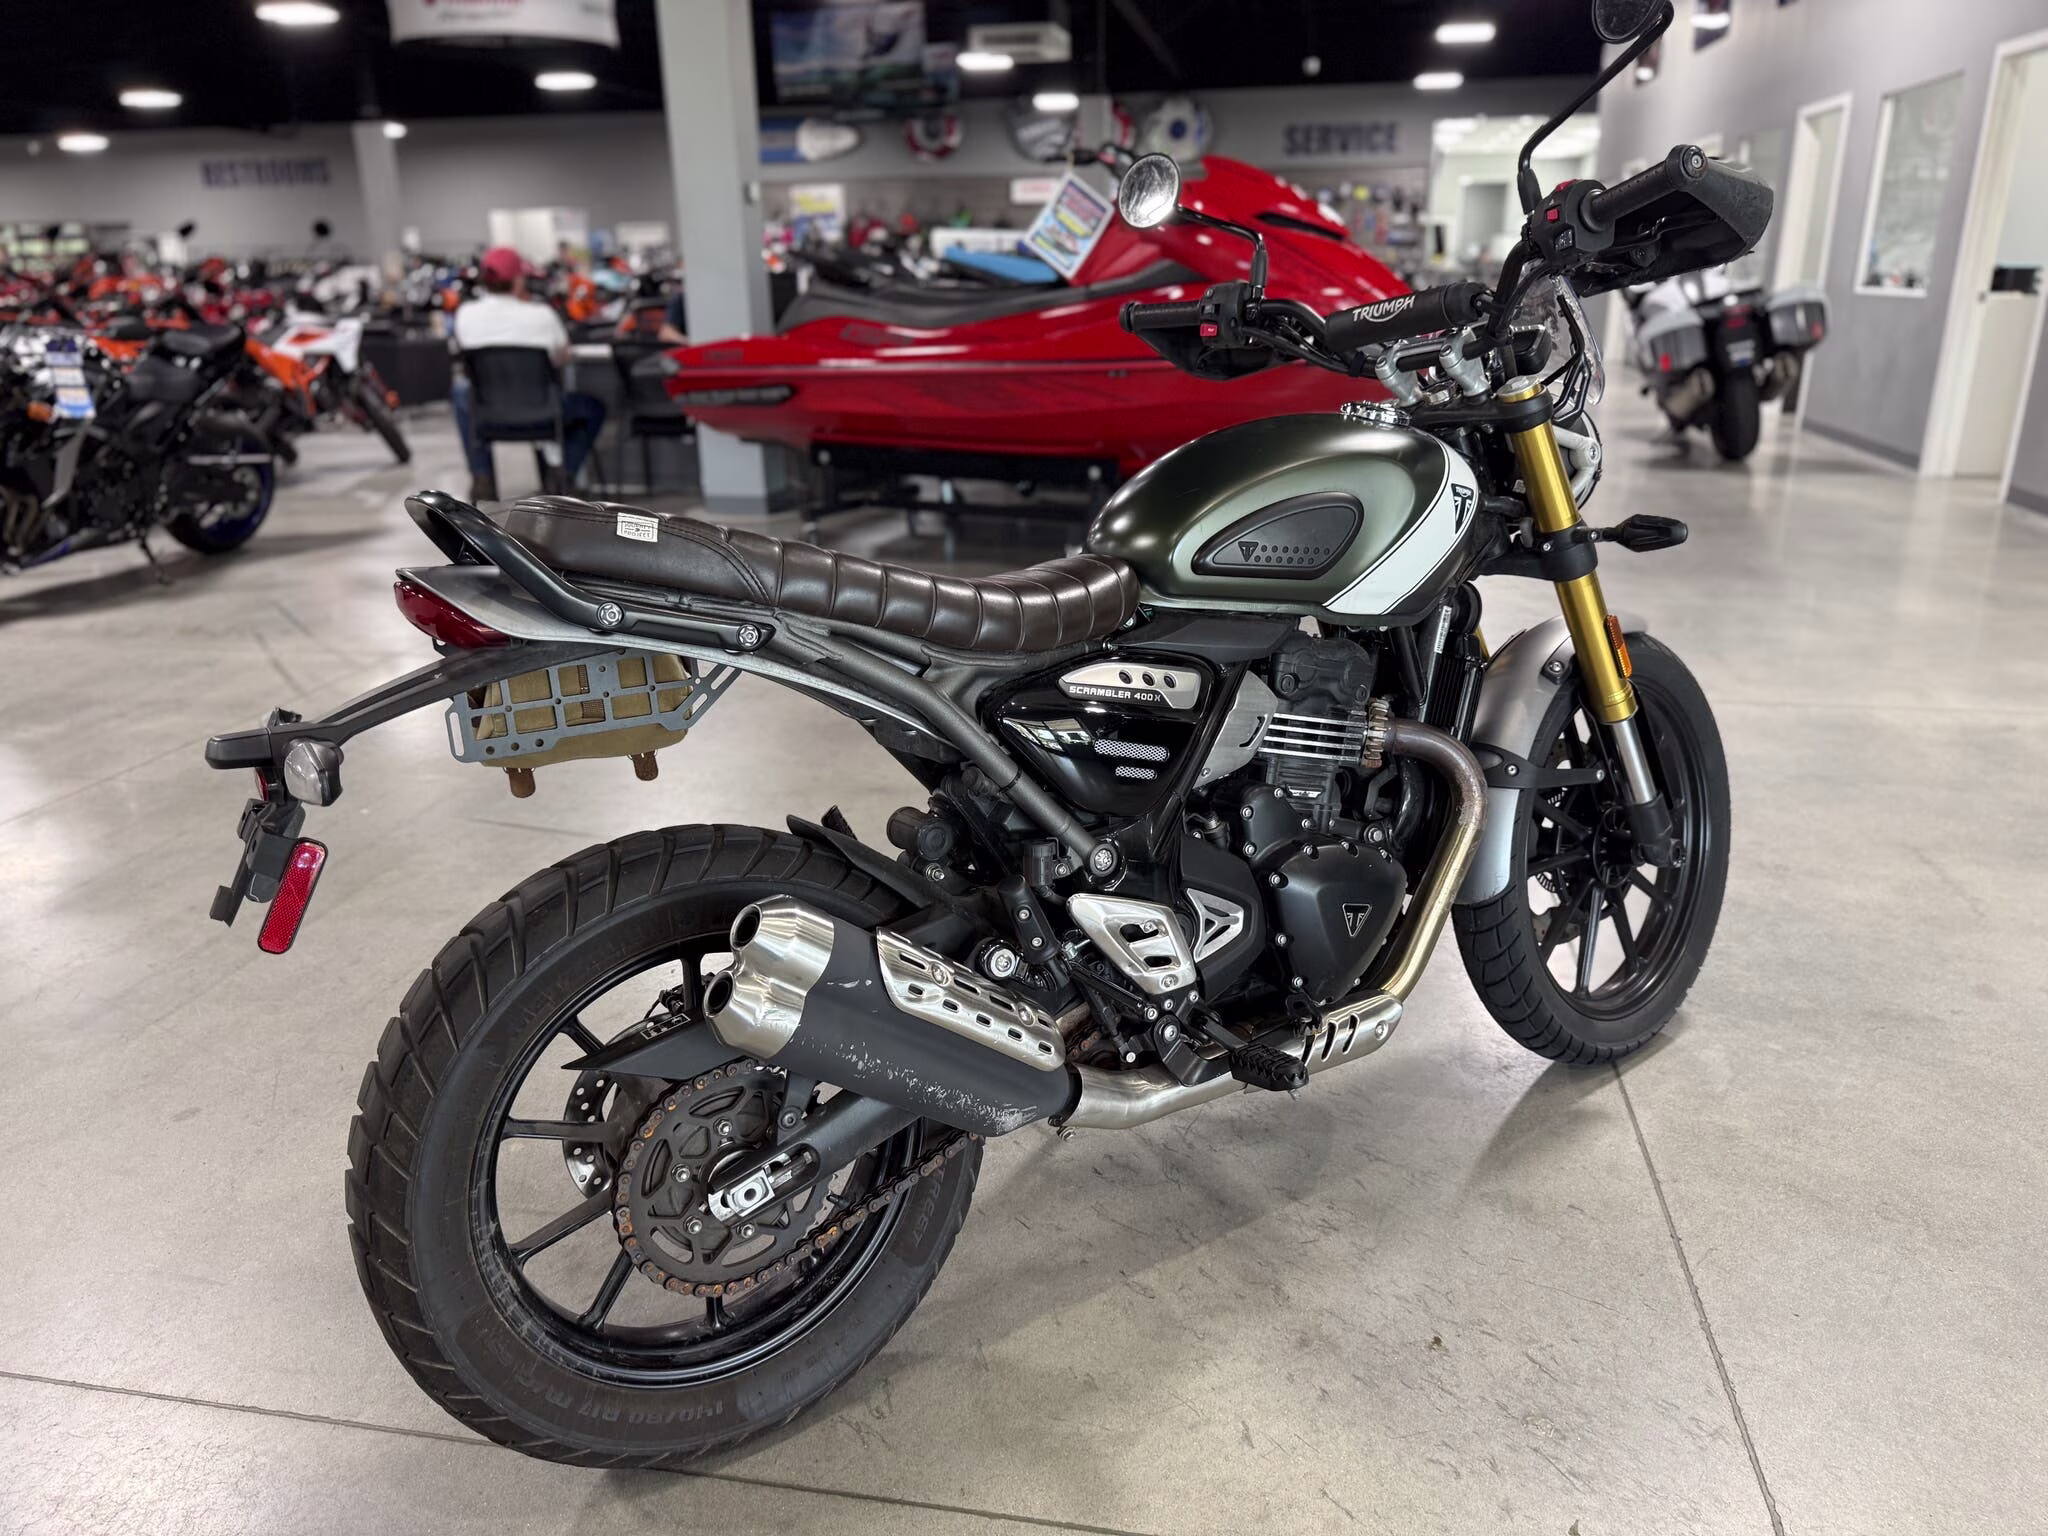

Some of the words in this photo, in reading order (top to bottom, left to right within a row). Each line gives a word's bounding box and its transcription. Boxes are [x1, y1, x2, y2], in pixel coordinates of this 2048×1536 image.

[1285, 122, 1396, 156] SERVICE
[1352, 295, 1416, 323] TRIUMPH
[1069, 685, 1131, 699] SCRAMBLER
